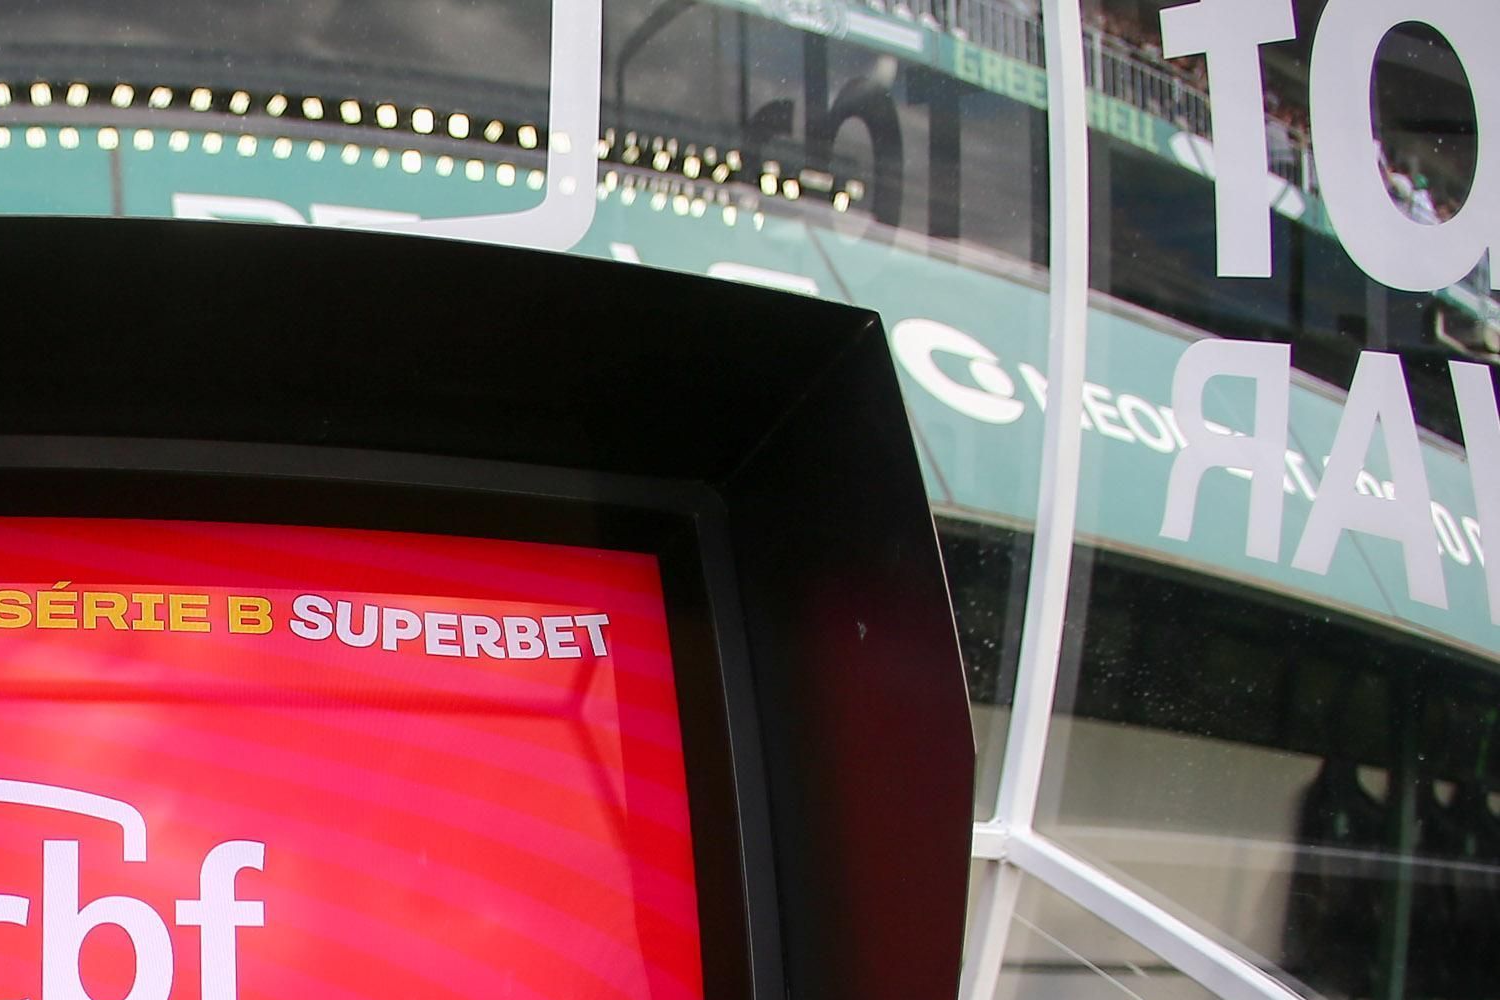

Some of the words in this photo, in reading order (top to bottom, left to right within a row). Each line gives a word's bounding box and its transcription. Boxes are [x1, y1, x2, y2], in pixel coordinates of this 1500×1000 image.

[953, 40, 1049, 111] GREE
[227, 594, 274, 634] B
[289, 594, 610, 660] SUPERBET
